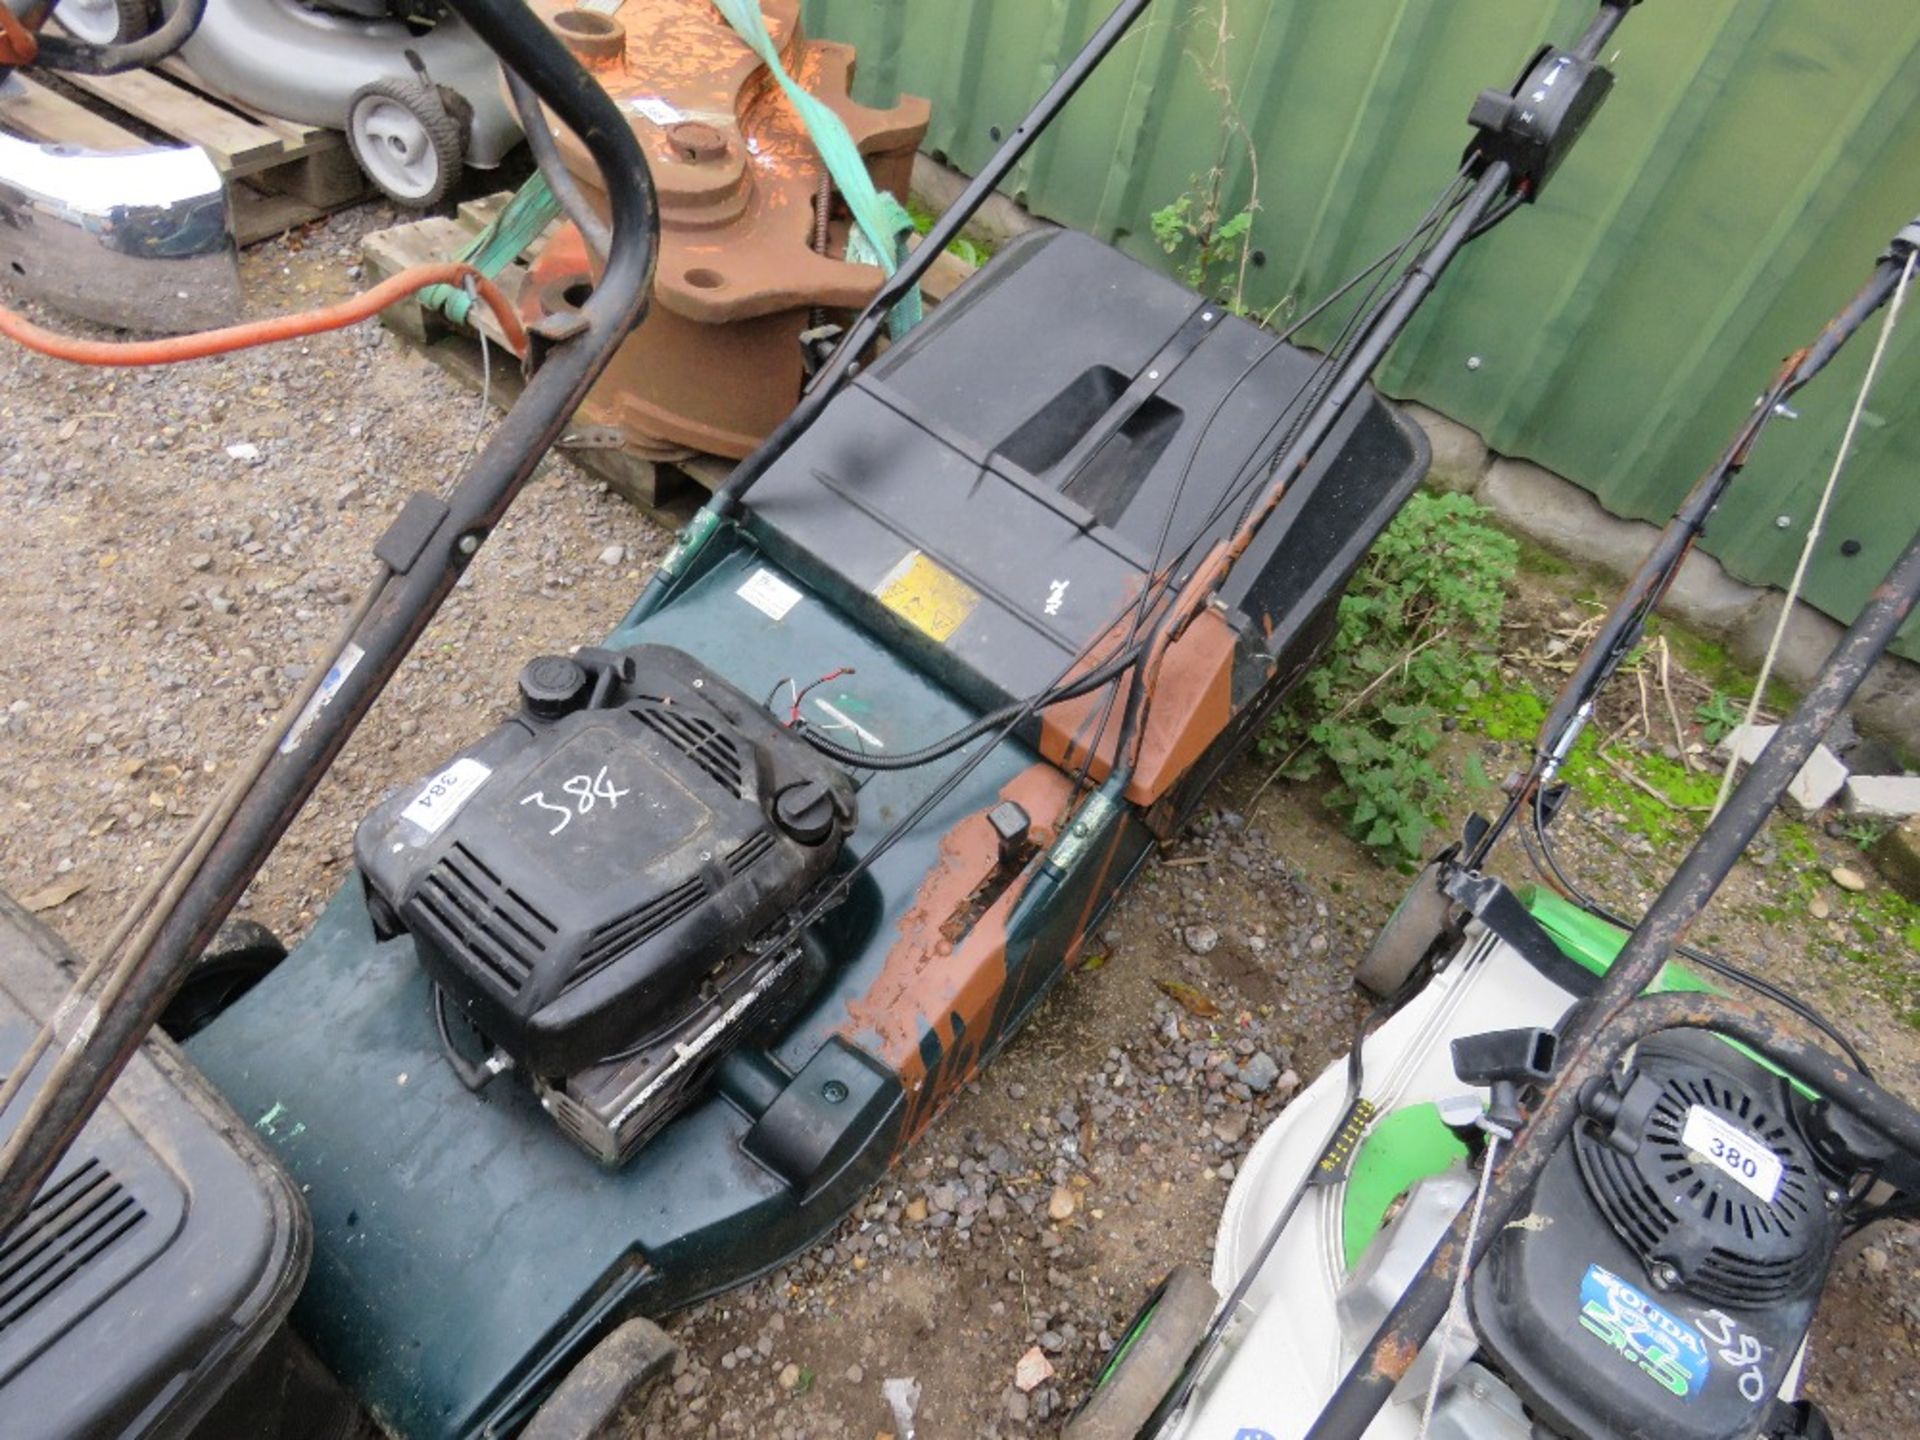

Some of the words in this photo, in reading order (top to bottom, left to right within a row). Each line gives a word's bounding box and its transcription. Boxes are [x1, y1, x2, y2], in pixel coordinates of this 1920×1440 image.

[420, 773, 458, 808] 384
[520, 766, 629, 836] 384
[1710, 1138, 1757, 1178] 380
[1695, 1309, 1764, 1402] 380
